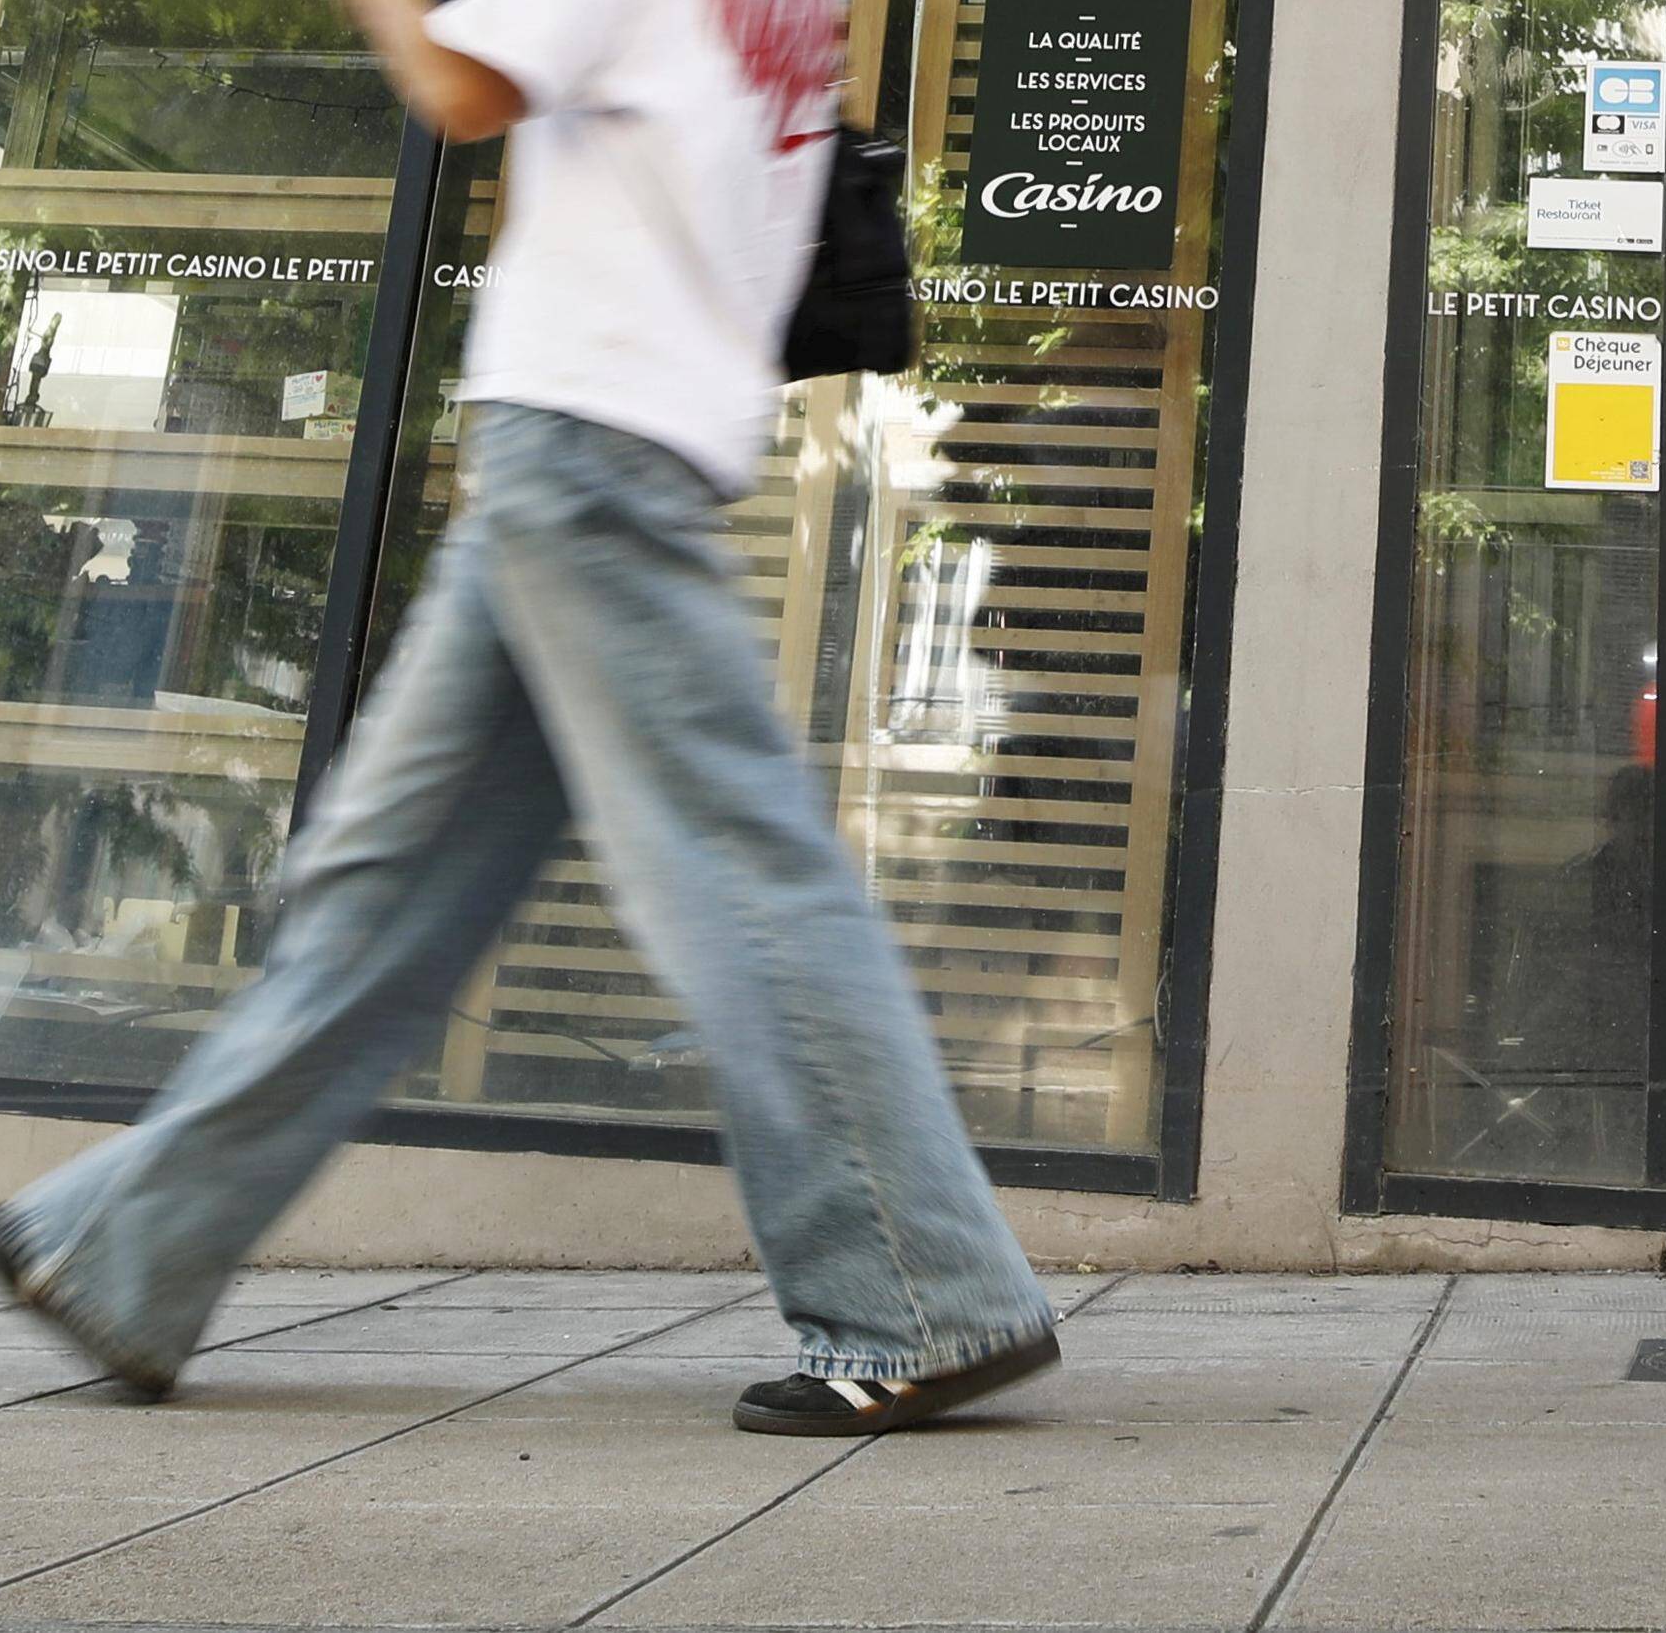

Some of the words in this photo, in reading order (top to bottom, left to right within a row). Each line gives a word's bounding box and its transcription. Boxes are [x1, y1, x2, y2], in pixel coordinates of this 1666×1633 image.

[1028, 32, 1053, 51] LA
[1058, 31, 1141, 51] QUALITÉ
[1017, 73, 1050, 90] LES
[1054, 73, 1146, 92] SERVICES
[1010, 113, 1043, 131] LES
[1048, 114, 1145, 132] PRODUITS
[1631, 120, 1657, 130] VISA
[1037, 135, 1121, 153] LOCAUX
[980, 171, 1163, 219] Casino
[1568, 199, 1601, 210] Ticket
[1537, 209, 1601, 221] Restaurant
[62, 250, 91, 274] LE
[96, 251, 163, 276] PETIT
[166, 254, 266, 279] CASINO
[271, 257, 301, 281] LE
[307, 258, 375, 282] PETIT
[994, 281, 1024, 304] LE
[1031, 282, 1103, 306] PETIT
[1108, 284, 1220, 309] CASINO
[1428, 292, 1458, 316] LE
[1467, 292, 1541, 318] PETIT
[1547, 294, 1662, 321] CASINO
[1574, 337, 1641, 355] Chèque
[1574, 355, 1653, 373] Déjeuner
